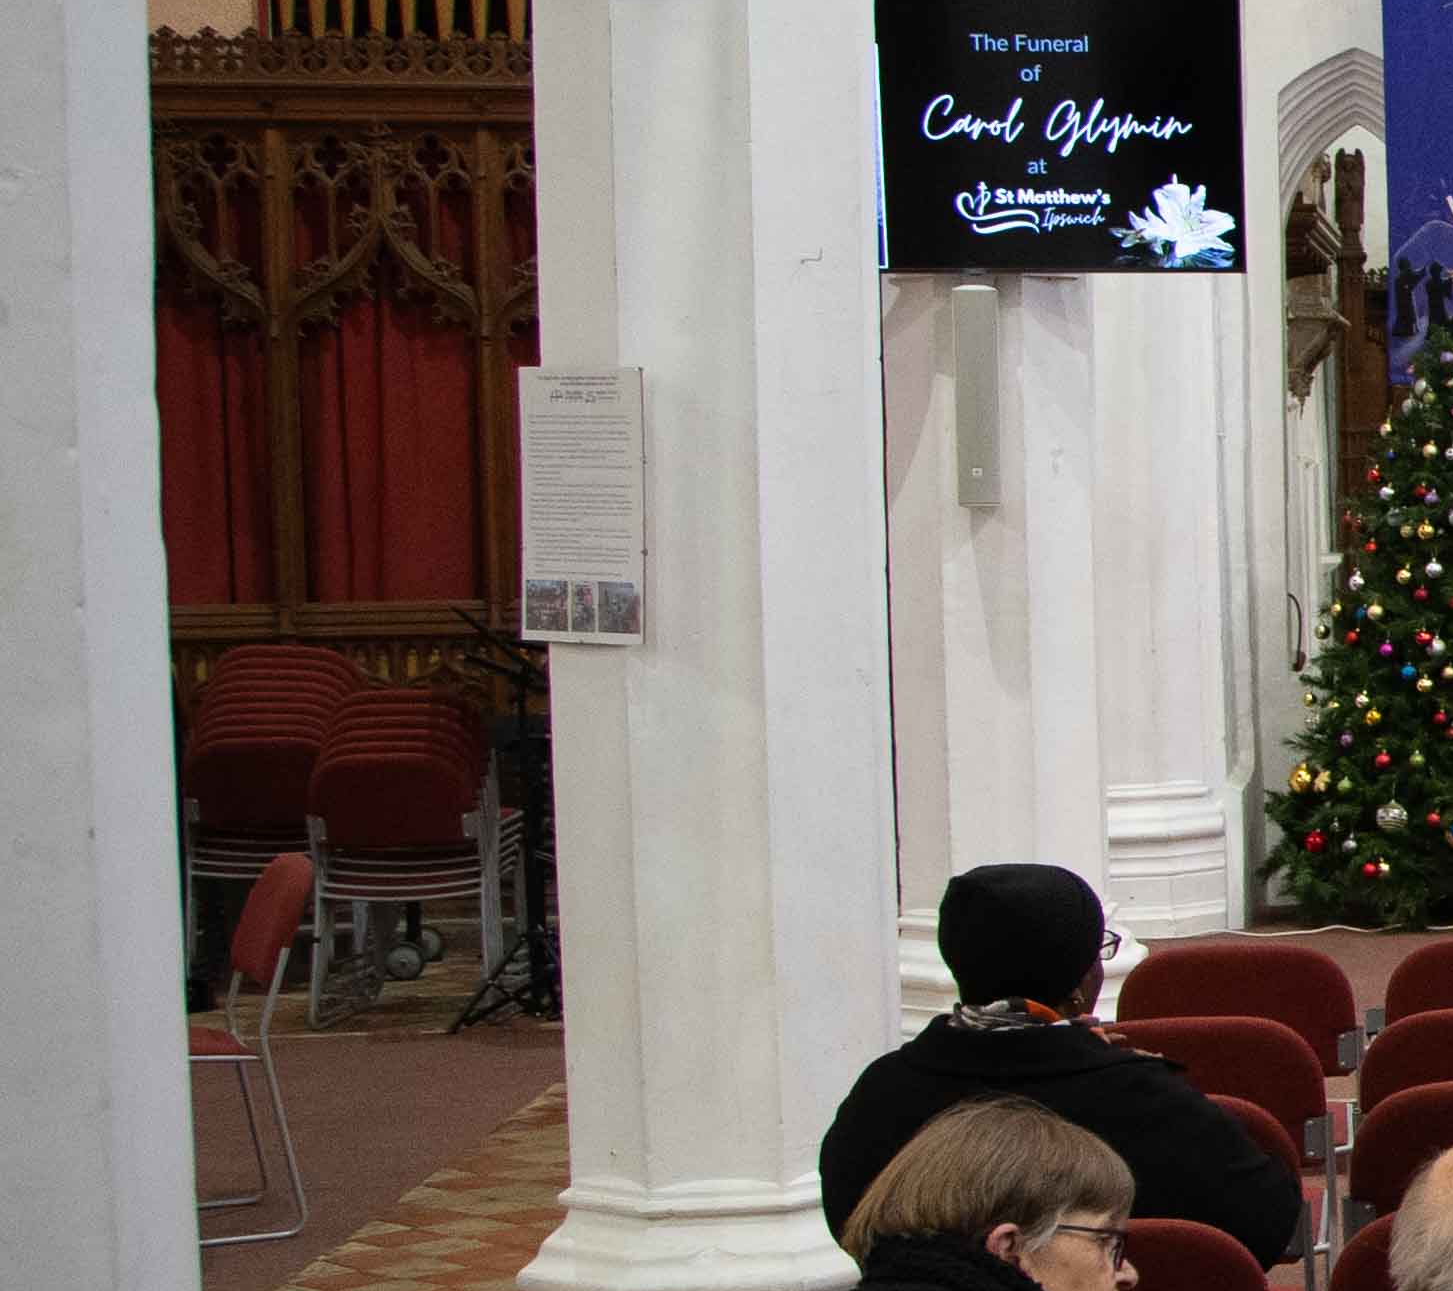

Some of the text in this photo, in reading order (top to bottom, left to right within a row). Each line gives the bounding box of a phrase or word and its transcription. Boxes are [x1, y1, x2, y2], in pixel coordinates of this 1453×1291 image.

[969, 33, 1089, 53] The Funeral
[1020, 64, 1042, 82] of
[923, 94, 1024, 143] Carol
[1027, 158, 1048, 174] at
[994, 187, 1111, 205] St Matthew's
[1041, 206, 1106, 232] Ipswich
